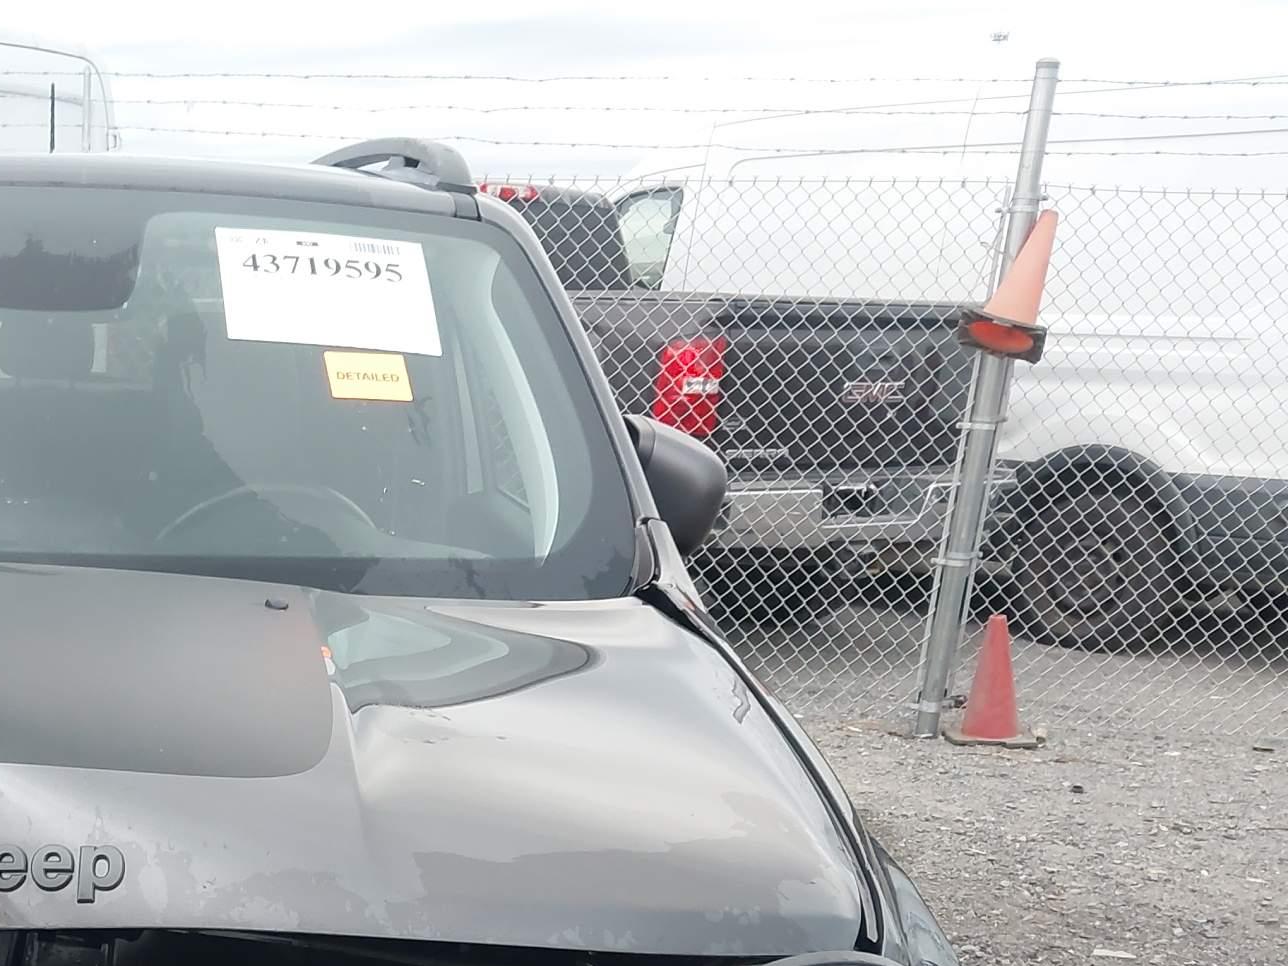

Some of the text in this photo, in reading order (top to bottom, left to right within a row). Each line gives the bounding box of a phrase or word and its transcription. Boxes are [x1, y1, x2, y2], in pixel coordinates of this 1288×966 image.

[242, 253, 403, 283] 43719595
[336, 370, 400, 383] DETAILED
[842, 381, 906, 403] GMC
